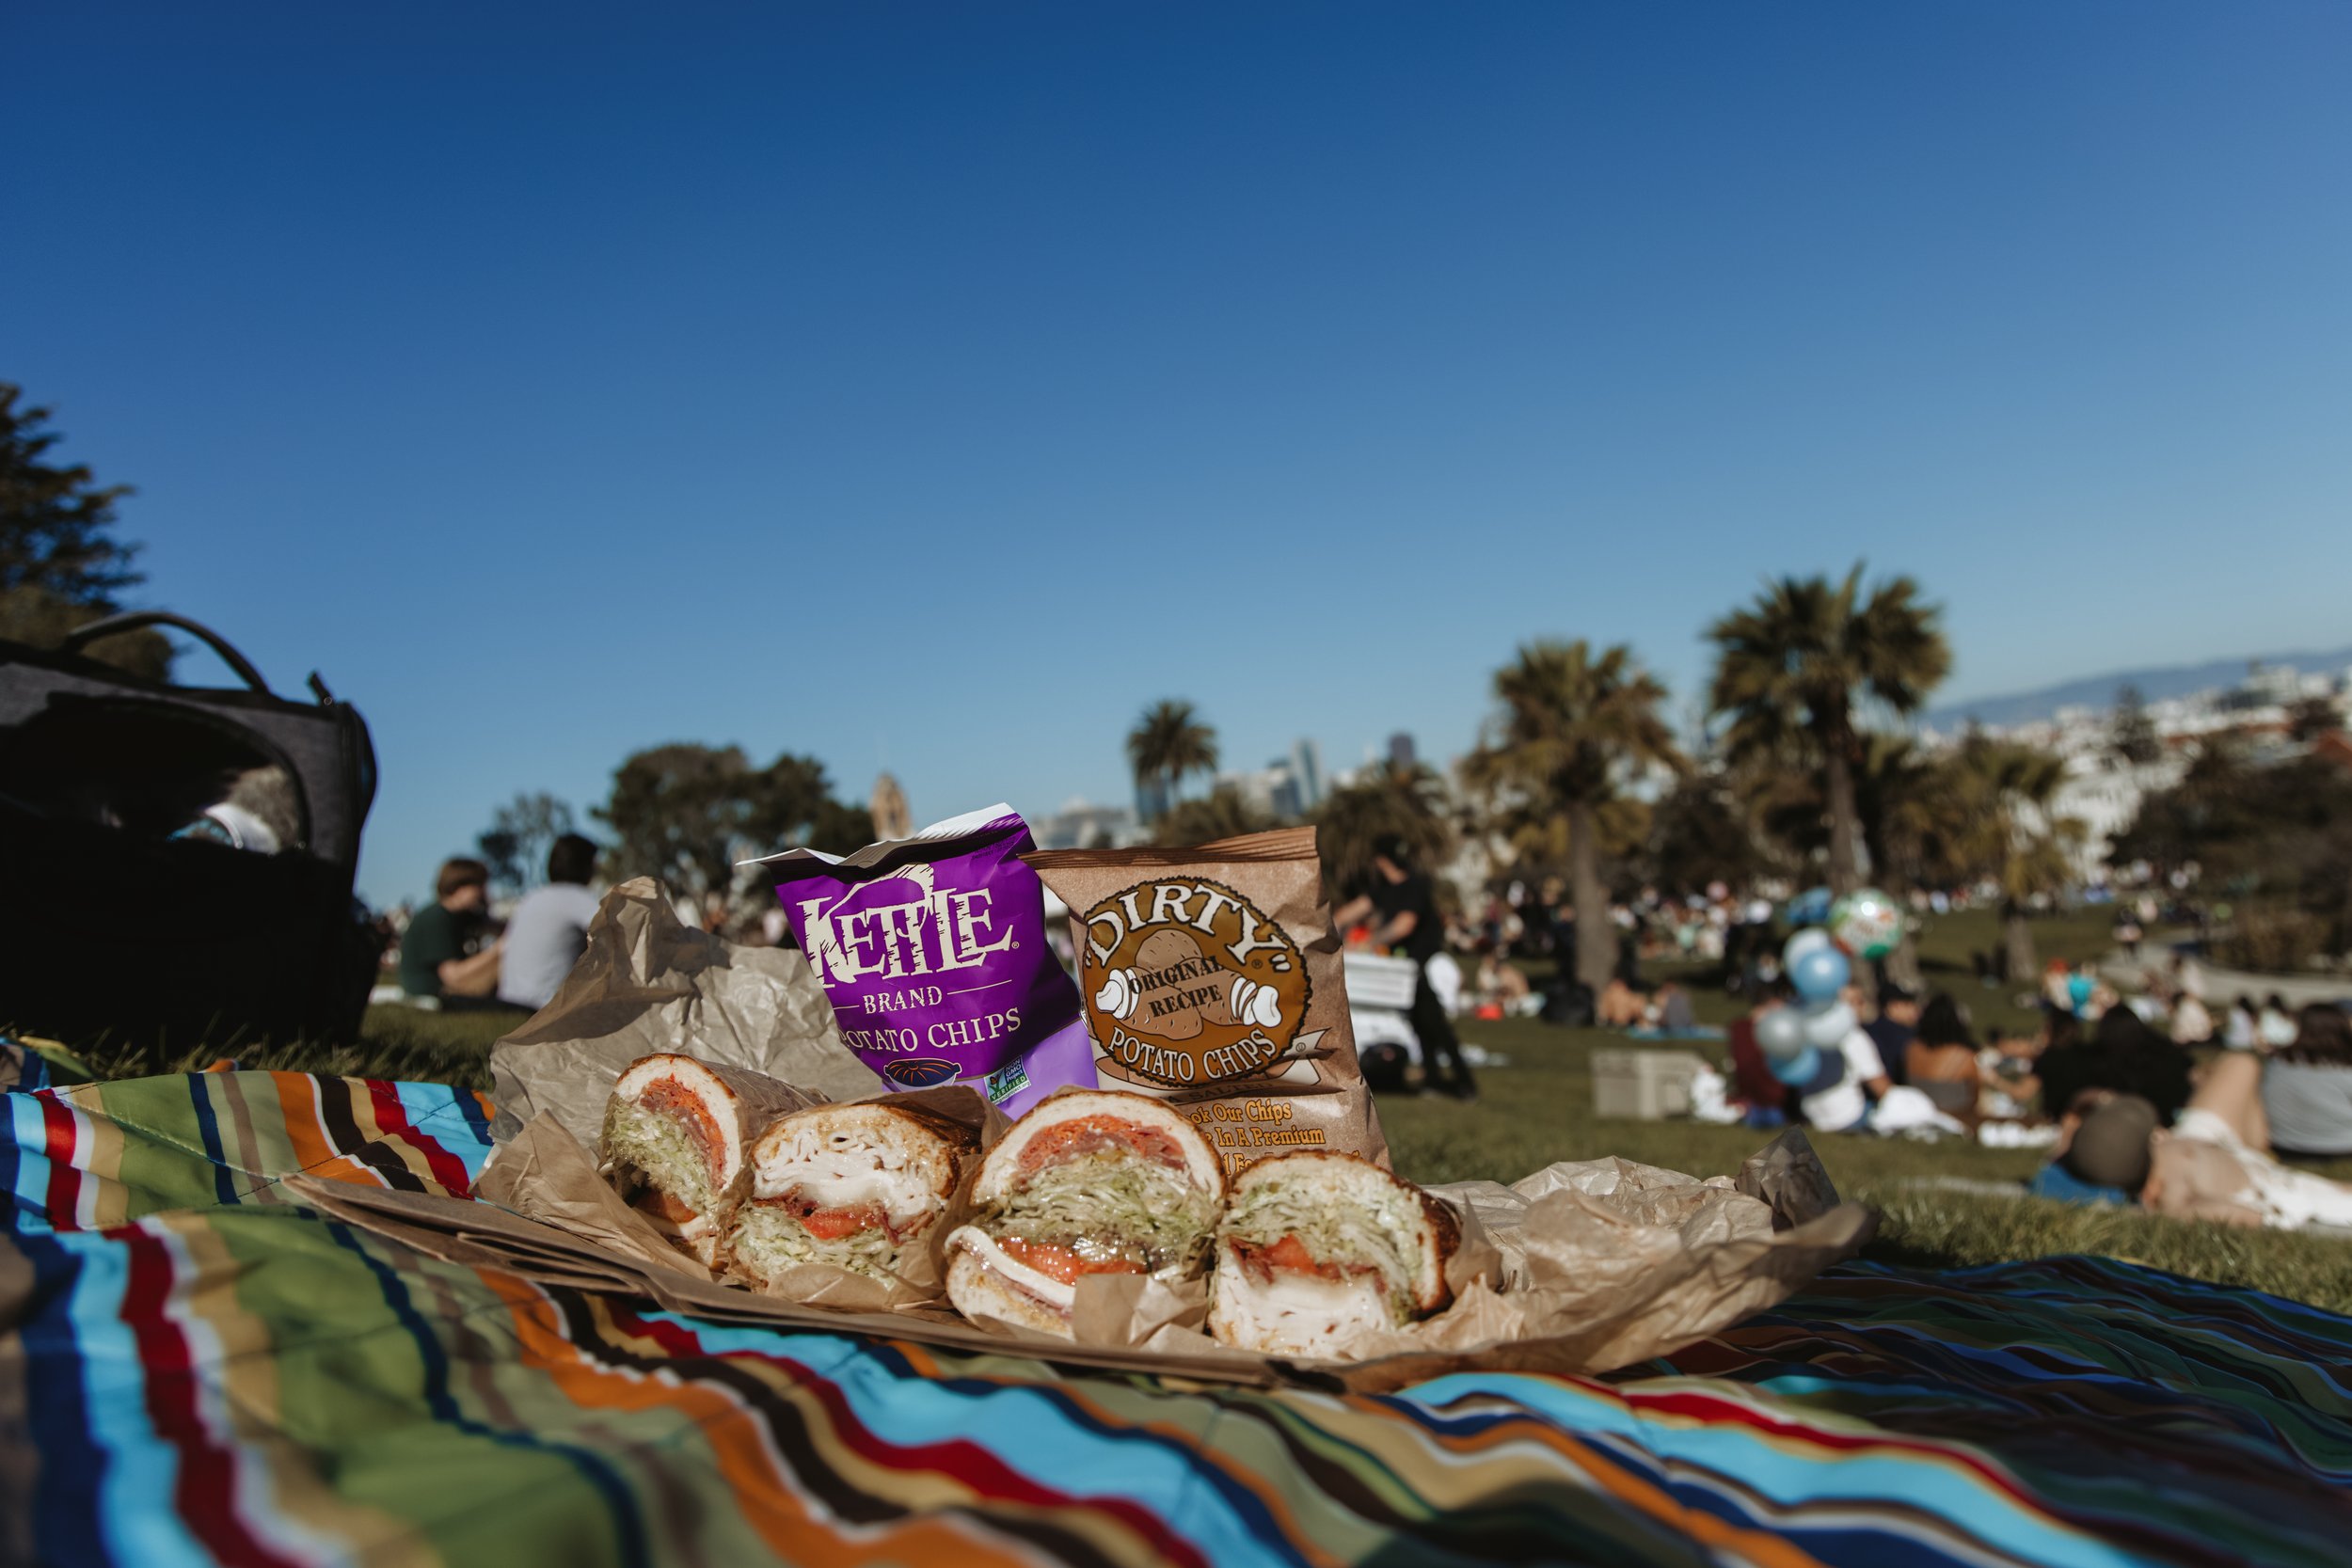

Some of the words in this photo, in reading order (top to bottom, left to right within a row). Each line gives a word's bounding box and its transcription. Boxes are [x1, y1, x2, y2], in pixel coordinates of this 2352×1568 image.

[797, 863, 1013, 989] KETTLE
[1129, 955, 1224, 995] ORIGINAL
[863, 986, 943, 1015] BRAND
[1148, 984, 1223, 1018] RECIPE
[928, 1006, 1022, 1049] CHIPS
[1107, 1026, 1195, 1082] POTATO
[1203, 1029, 1277, 1079] CHIPS
[1006, 1064, 1022, 1077] GMO
[992, 1075, 1026, 1101] VERIFIED
[1212, 1103, 1244, 1123] Our
[1245, 1099, 1293, 1126] Chips
[1215, 1126, 1235, 1147] In
[1235, 1127, 1252, 1147] A
[1249, 1124, 1327, 1147] Premium
